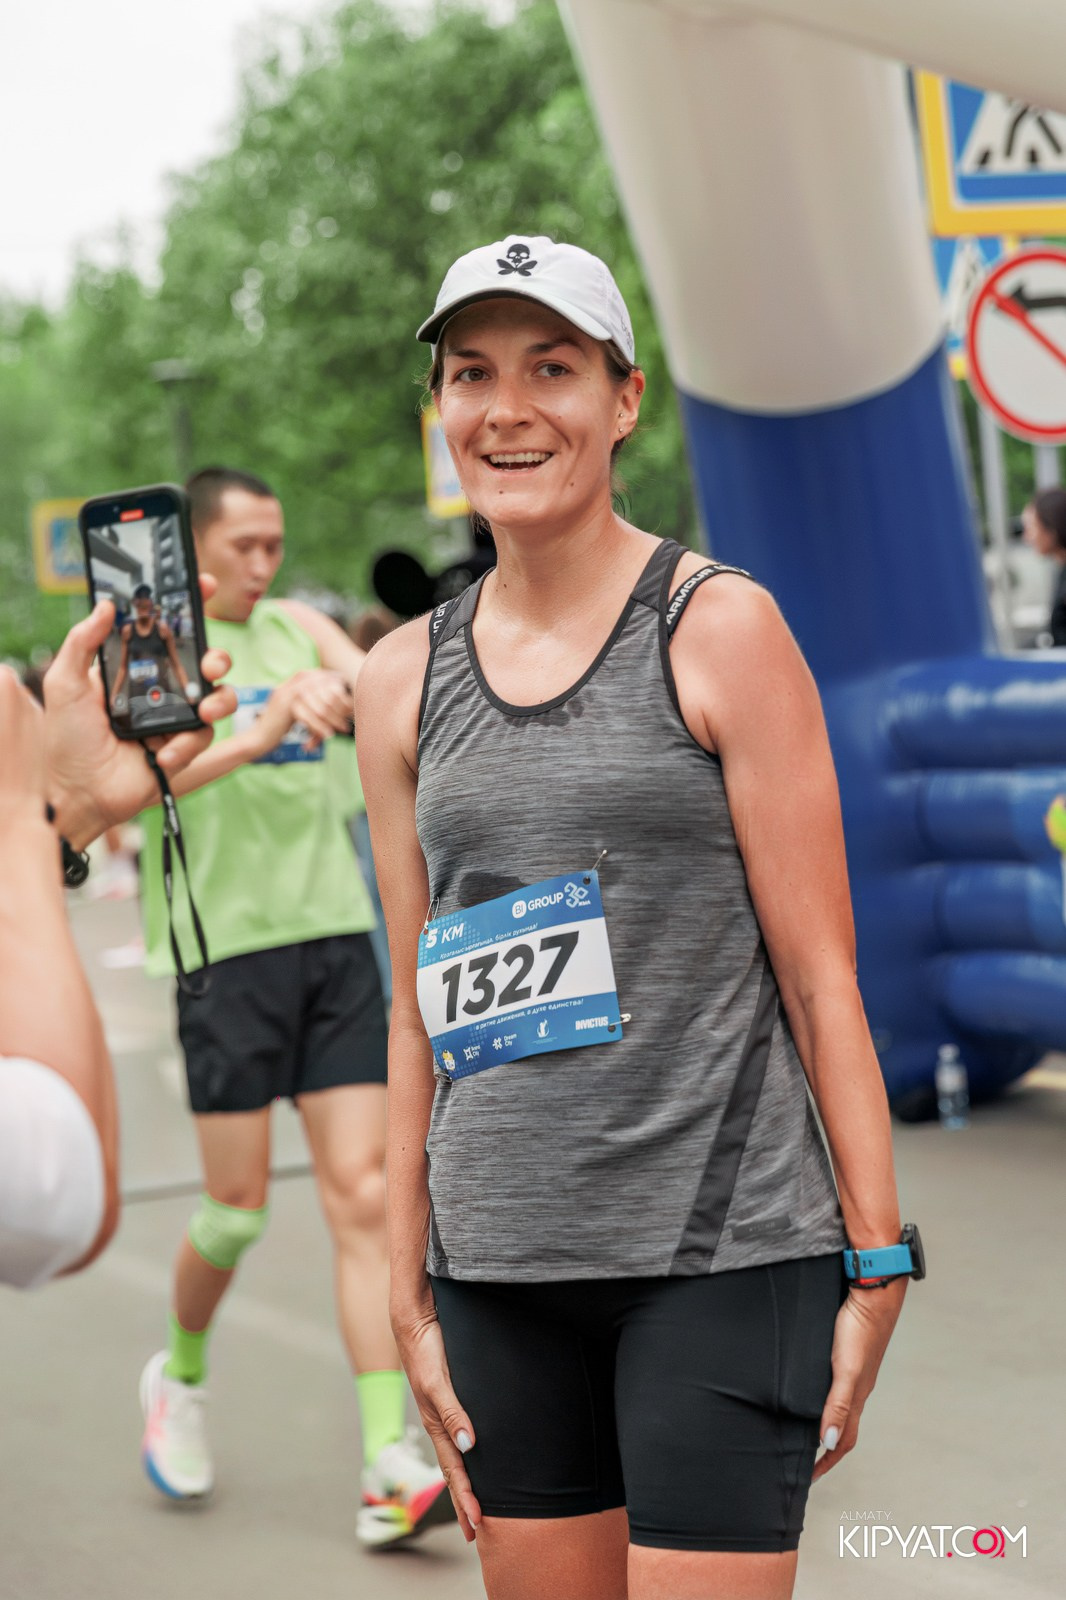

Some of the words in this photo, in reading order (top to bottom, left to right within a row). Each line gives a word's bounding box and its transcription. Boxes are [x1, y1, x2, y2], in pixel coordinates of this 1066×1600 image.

[666, 568, 715, 625] ARMOUR
[528, 892, 564, 911] GROUP
[425, 927, 439, 949] 5
[442, 930, 579, 1024] 1327
[548, 998, 584, 1011] единства!
[575, 1016, 609, 1031] INVICTUS
